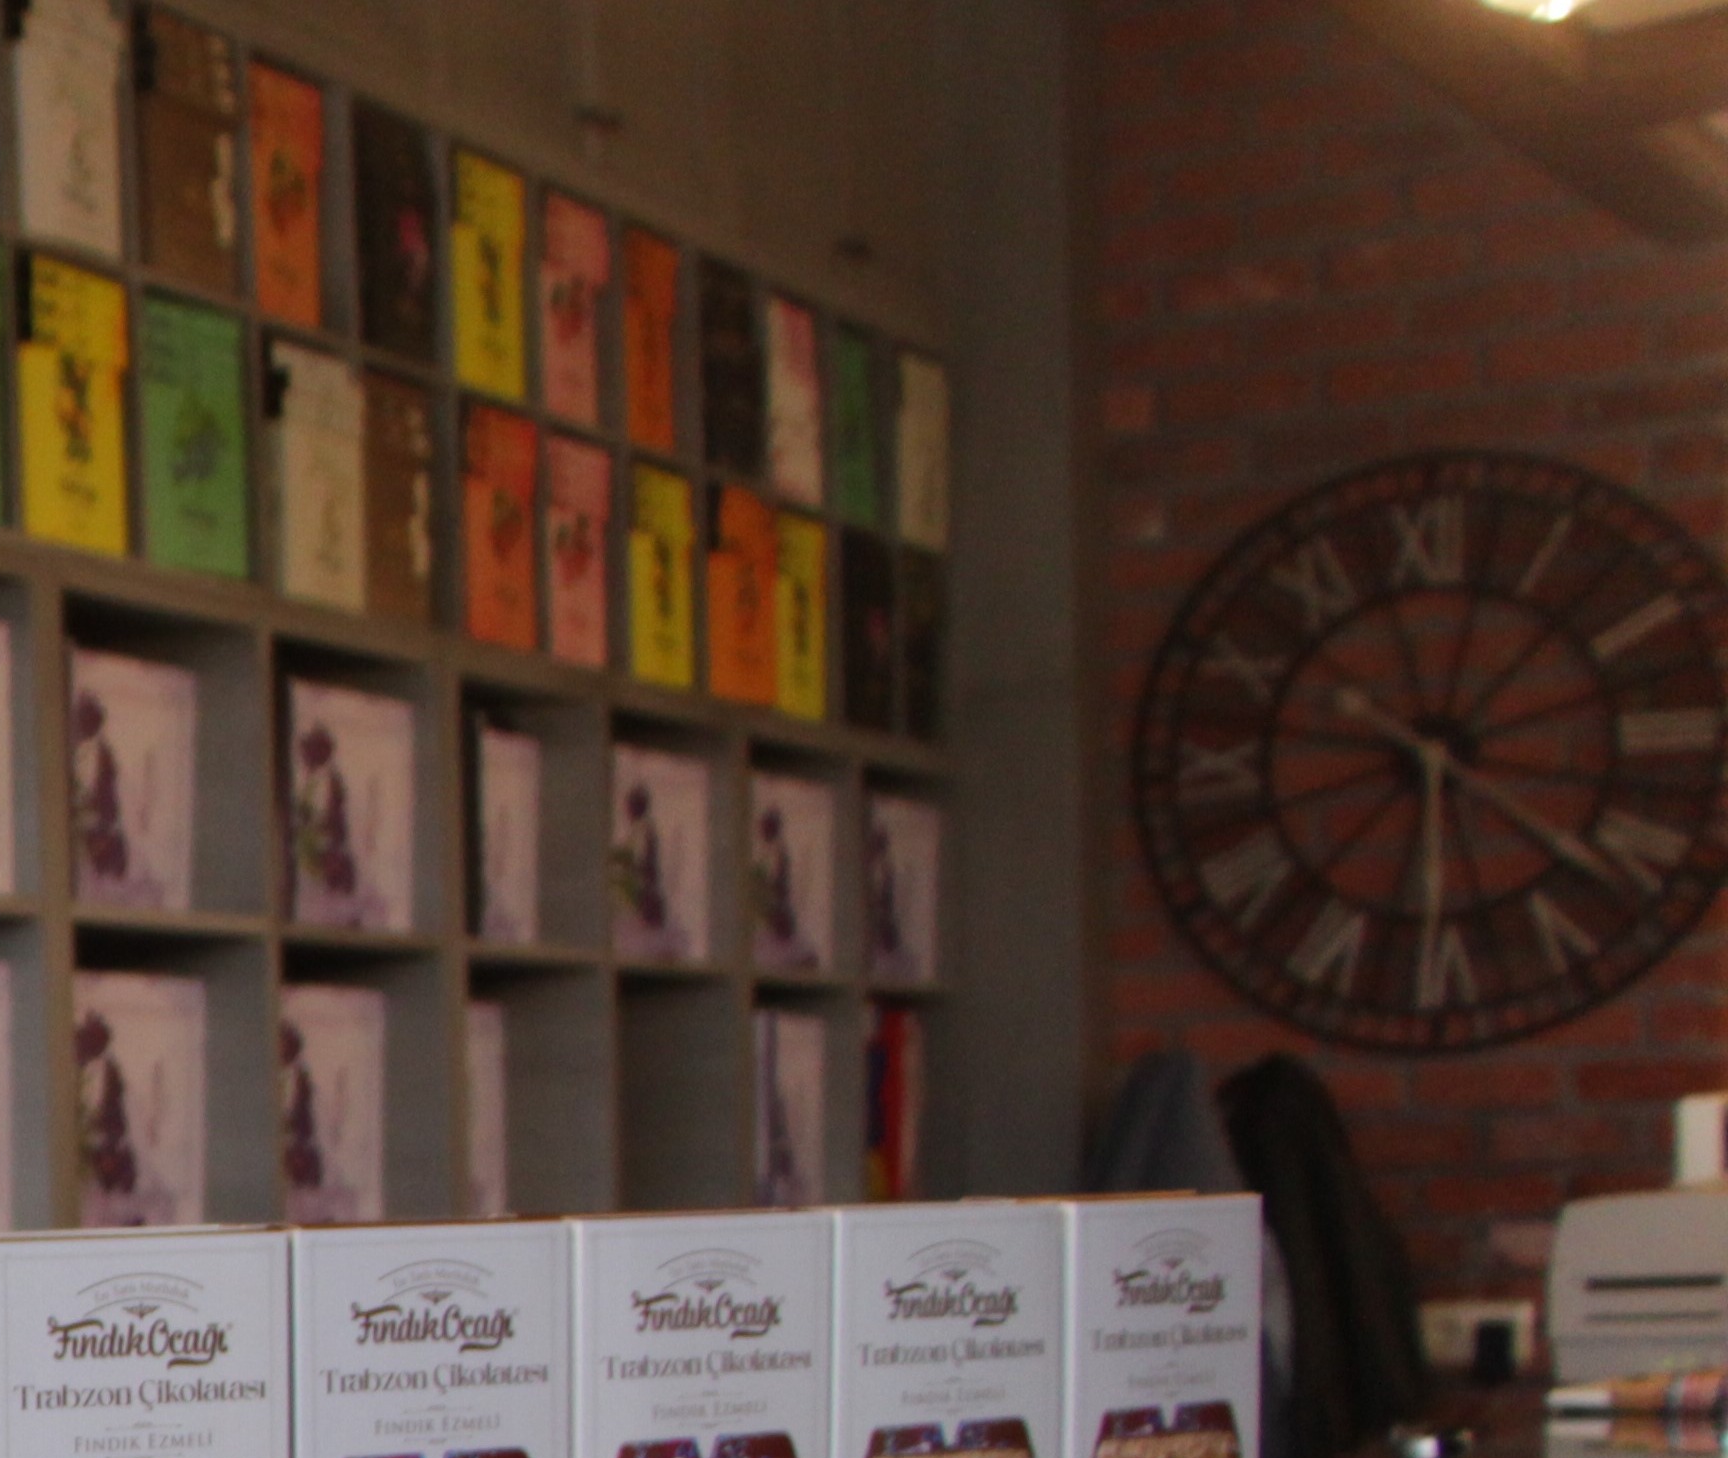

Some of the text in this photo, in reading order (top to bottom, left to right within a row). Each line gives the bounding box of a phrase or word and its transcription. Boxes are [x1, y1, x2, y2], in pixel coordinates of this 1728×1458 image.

[320, 1363, 548, 1395] Trabzon Çikolatası
[13, 1379, 266, 1412] Trabzon Çikolatası
[74, 1436, 140, 1453] FINDIK
